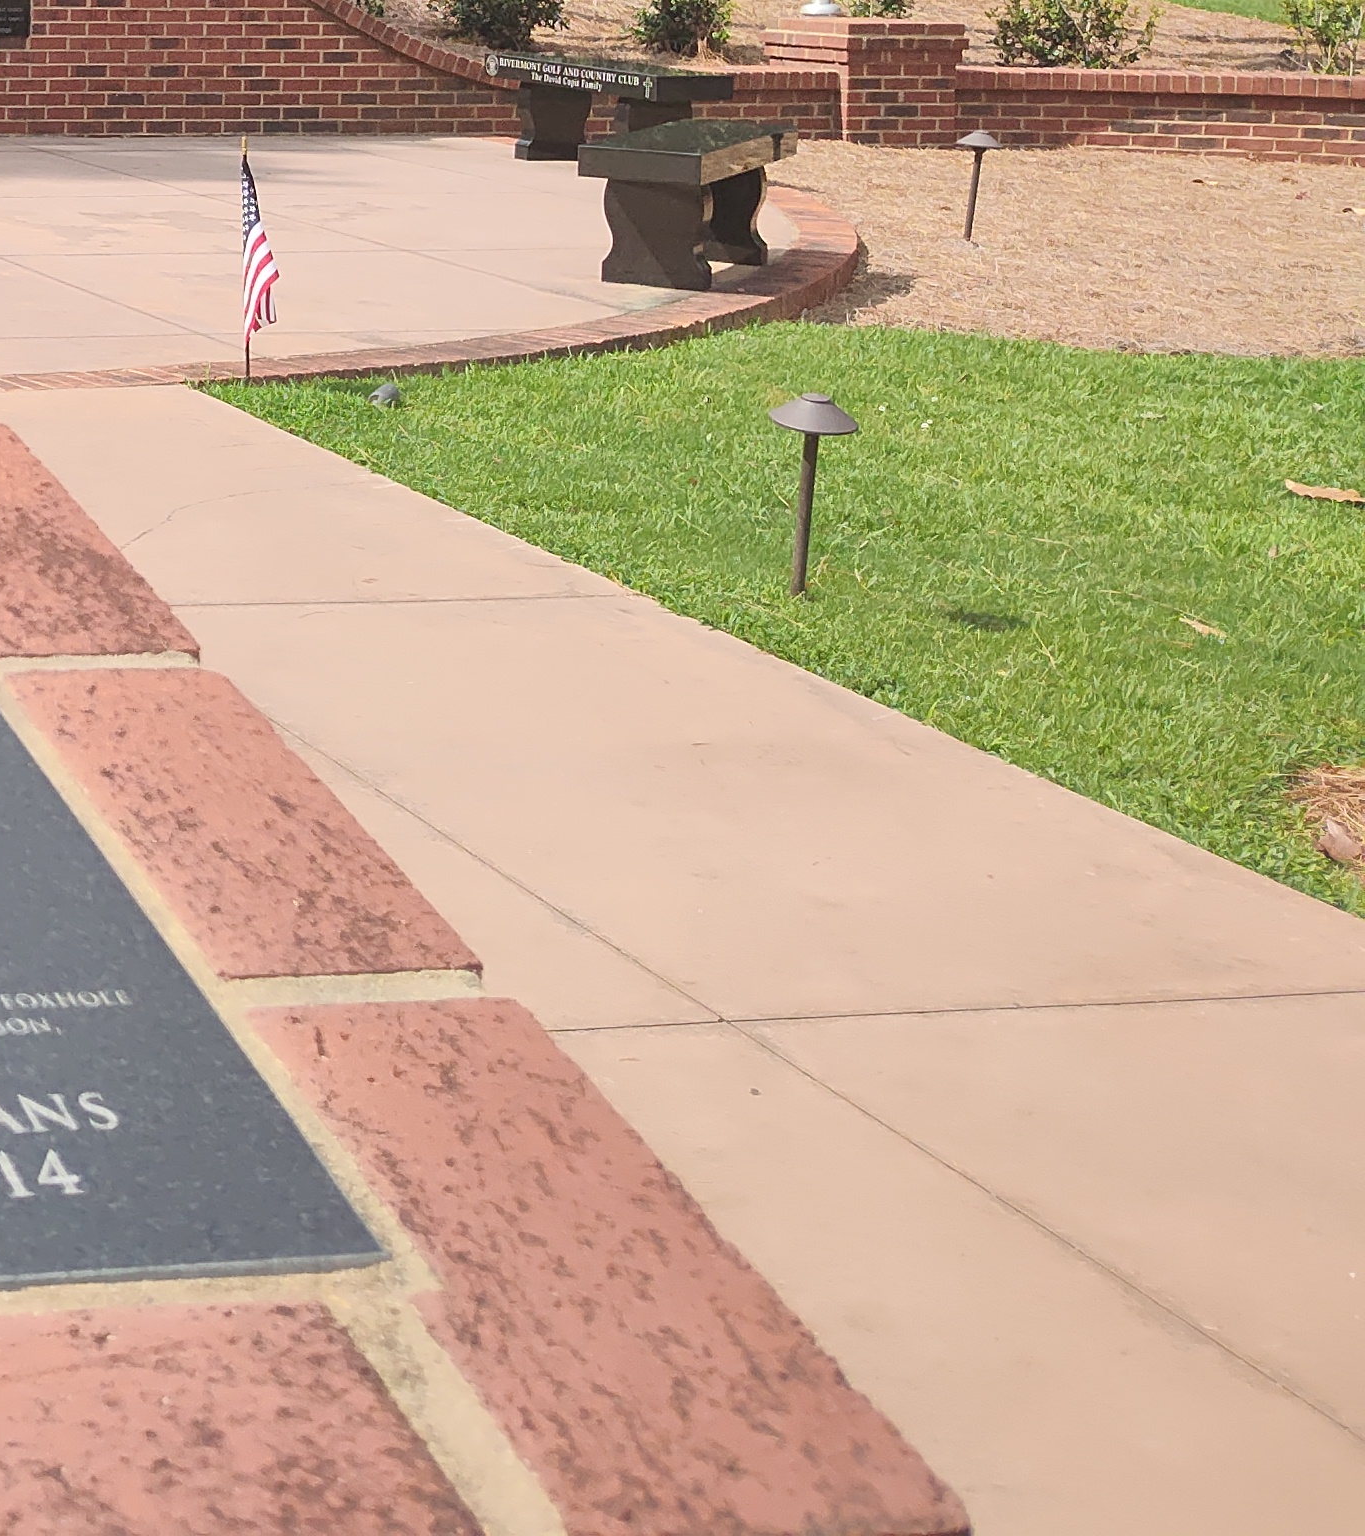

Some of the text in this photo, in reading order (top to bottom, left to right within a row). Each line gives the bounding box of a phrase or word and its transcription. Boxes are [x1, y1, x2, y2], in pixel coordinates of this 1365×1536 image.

[499, 58, 640, 86] RIVERMONT GOLF AND COUNTRY CLUB
[531, 72, 542, 81] The
[581, 79, 602, 92] Family
[0, 989, 132, 1010] FOXHOLE
